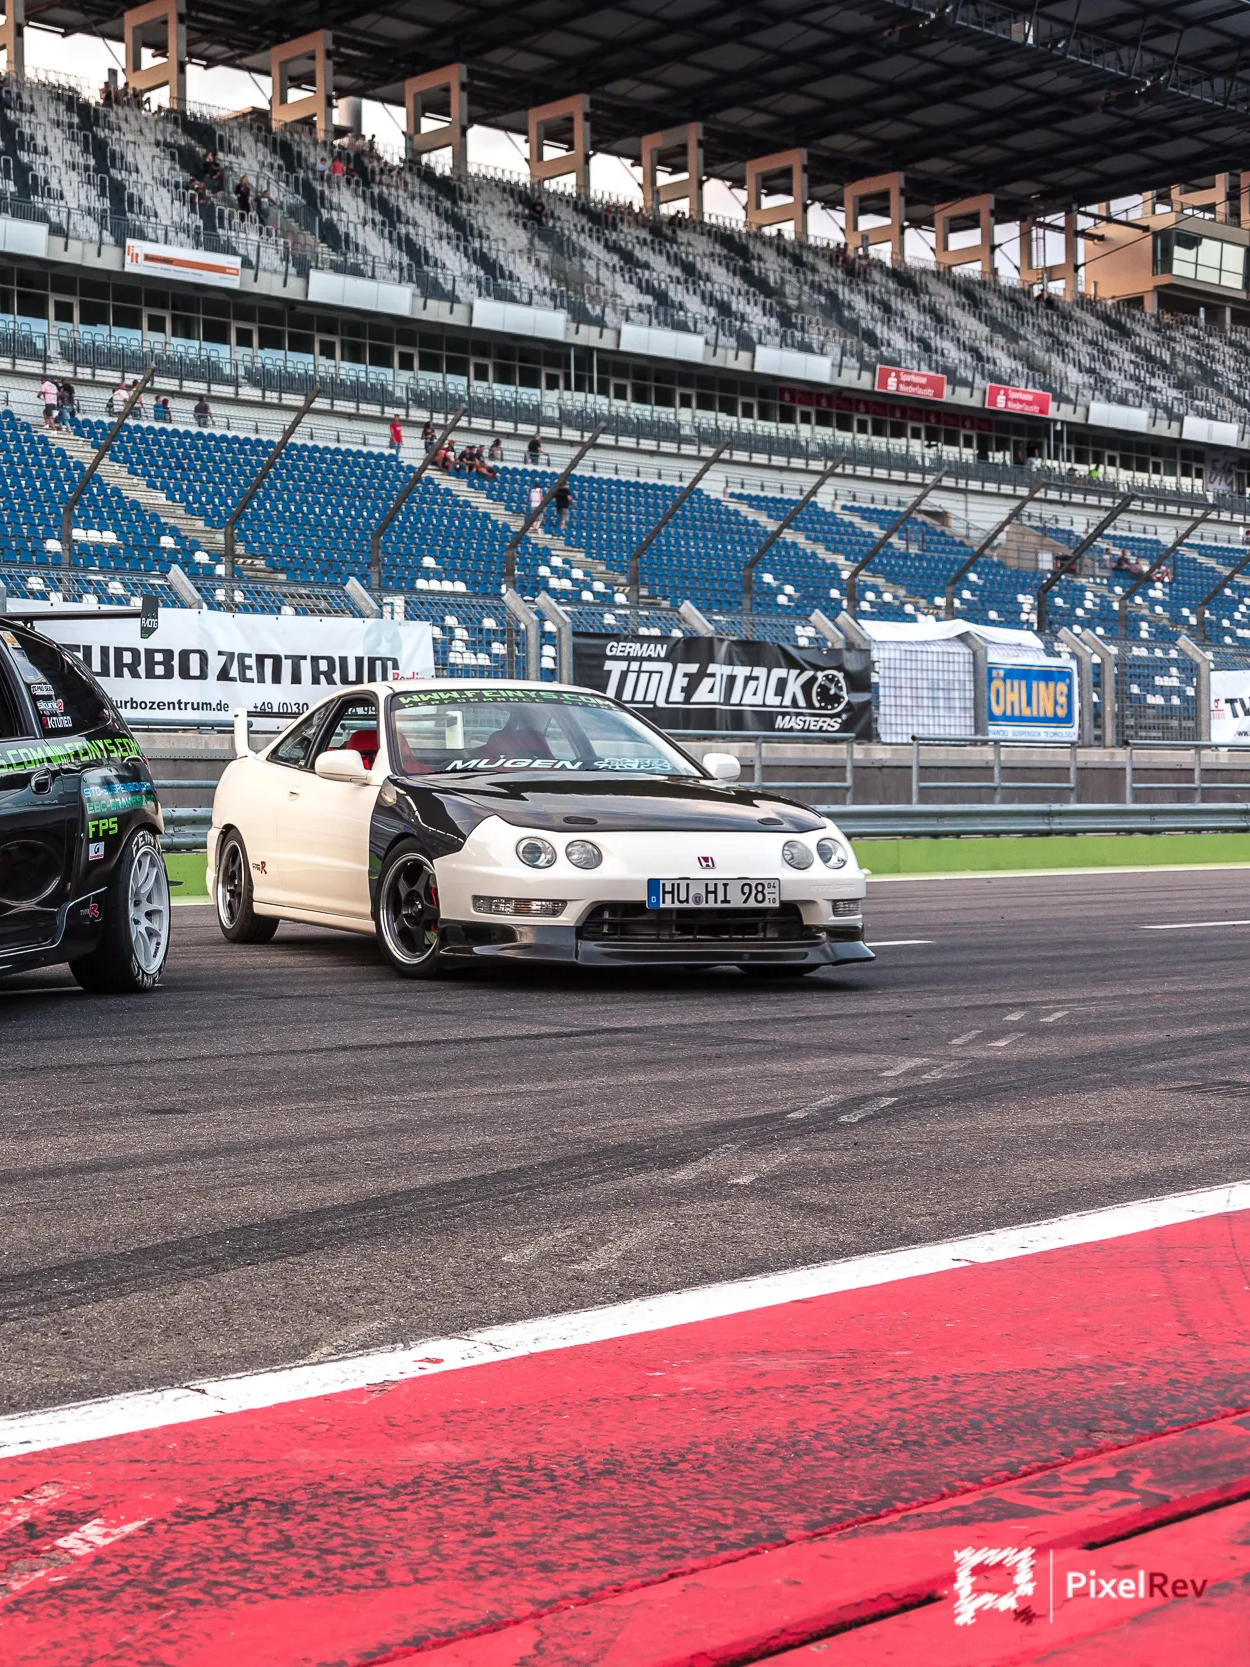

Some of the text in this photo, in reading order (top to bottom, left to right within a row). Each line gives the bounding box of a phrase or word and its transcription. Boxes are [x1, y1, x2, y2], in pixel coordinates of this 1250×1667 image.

[606, 641, 667, 658] GERMAN
[399, 690, 616, 708] WWW.FEINYS.COM
[991, 669, 1069, 718] ÖHLINS
[775, 715, 842, 731] MASTERS
[88, 817, 118, 838] FPS
[662, 883, 690, 904] HU
[705, 883, 731, 904] HI
[740, 883, 766, 904] 98
